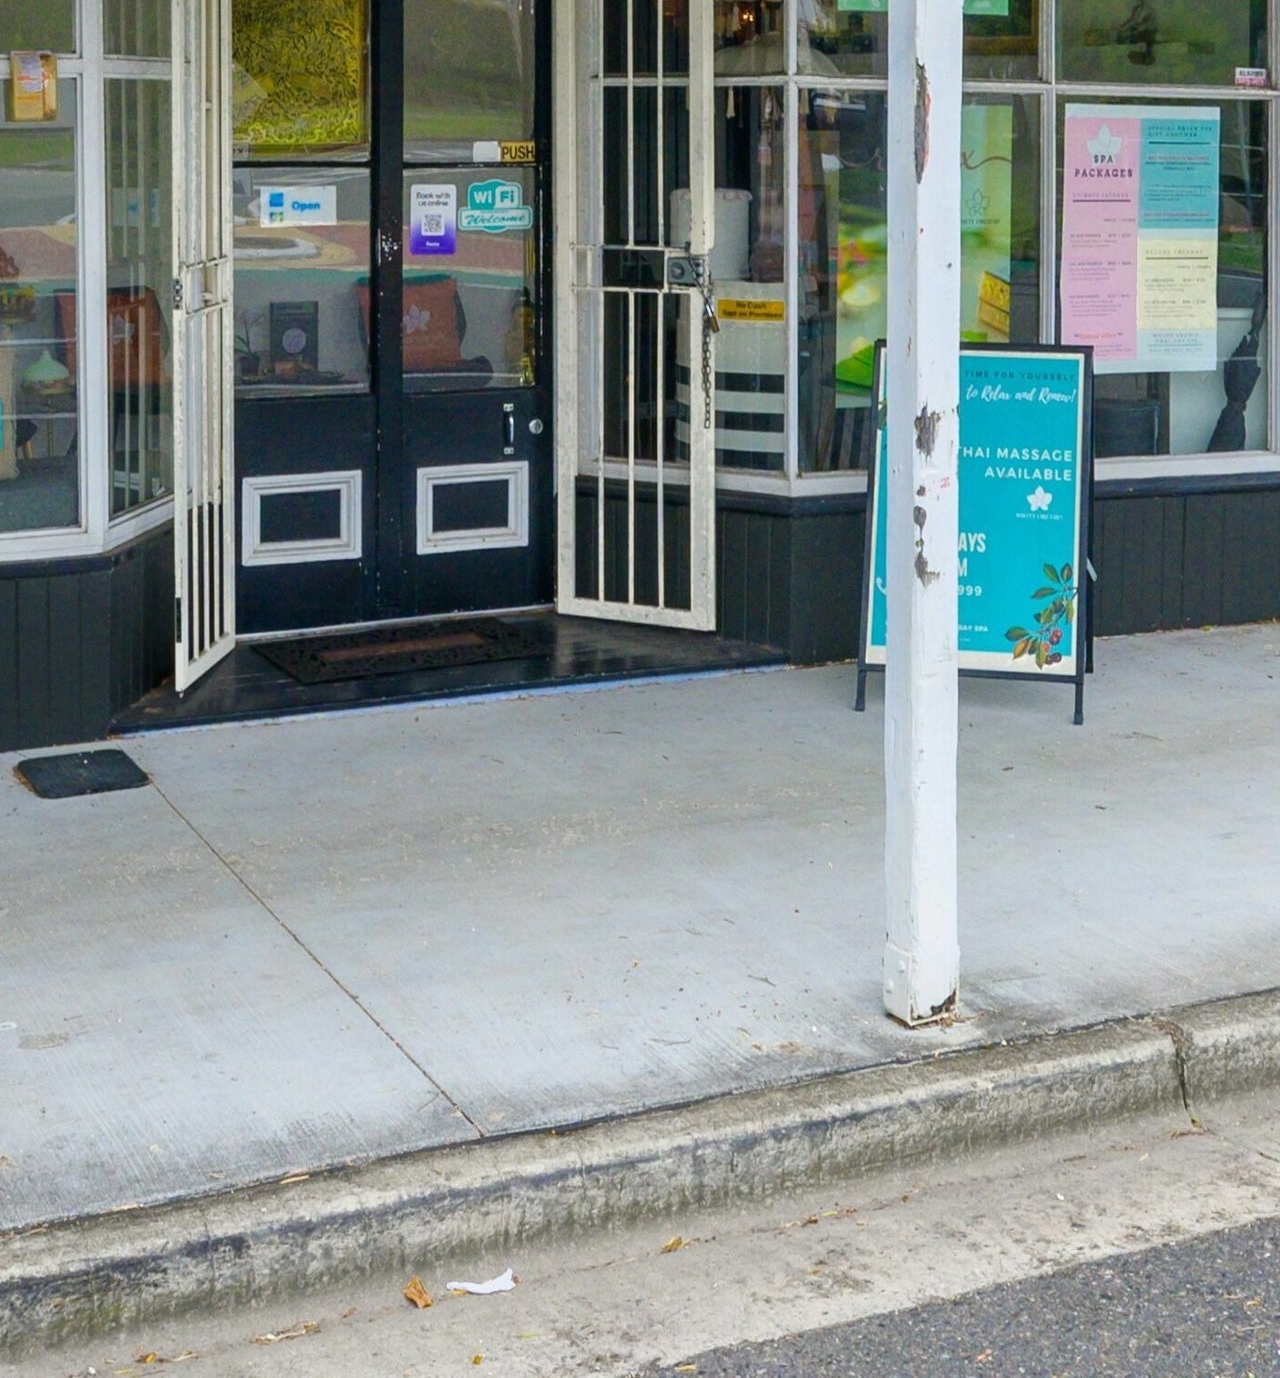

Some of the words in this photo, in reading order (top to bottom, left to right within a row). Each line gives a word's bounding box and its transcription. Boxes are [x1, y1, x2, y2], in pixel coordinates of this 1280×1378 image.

[501, 145, 535, 160] PUSH
[1093, 154, 1113, 163] SPA
[1074, 168, 1133, 178] PACKAGES
[291, 201, 321, 212] Open
[463, 213, 525, 226] Welcome
[965, 369, 989, 379] TIME
[994, 371, 1015, 380] FOR
[1020, 372, 1076, 382] YOURSELF
[966, 384, 978, 400] to
[980, 384, 1012, 403] Relax
[1014, 388, 1034, 401] and
[996, 447, 1073, 462] MASSAGE
[984, 466, 1073, 482] AVAILABLE
[958, 532, 987, 553] AYS
